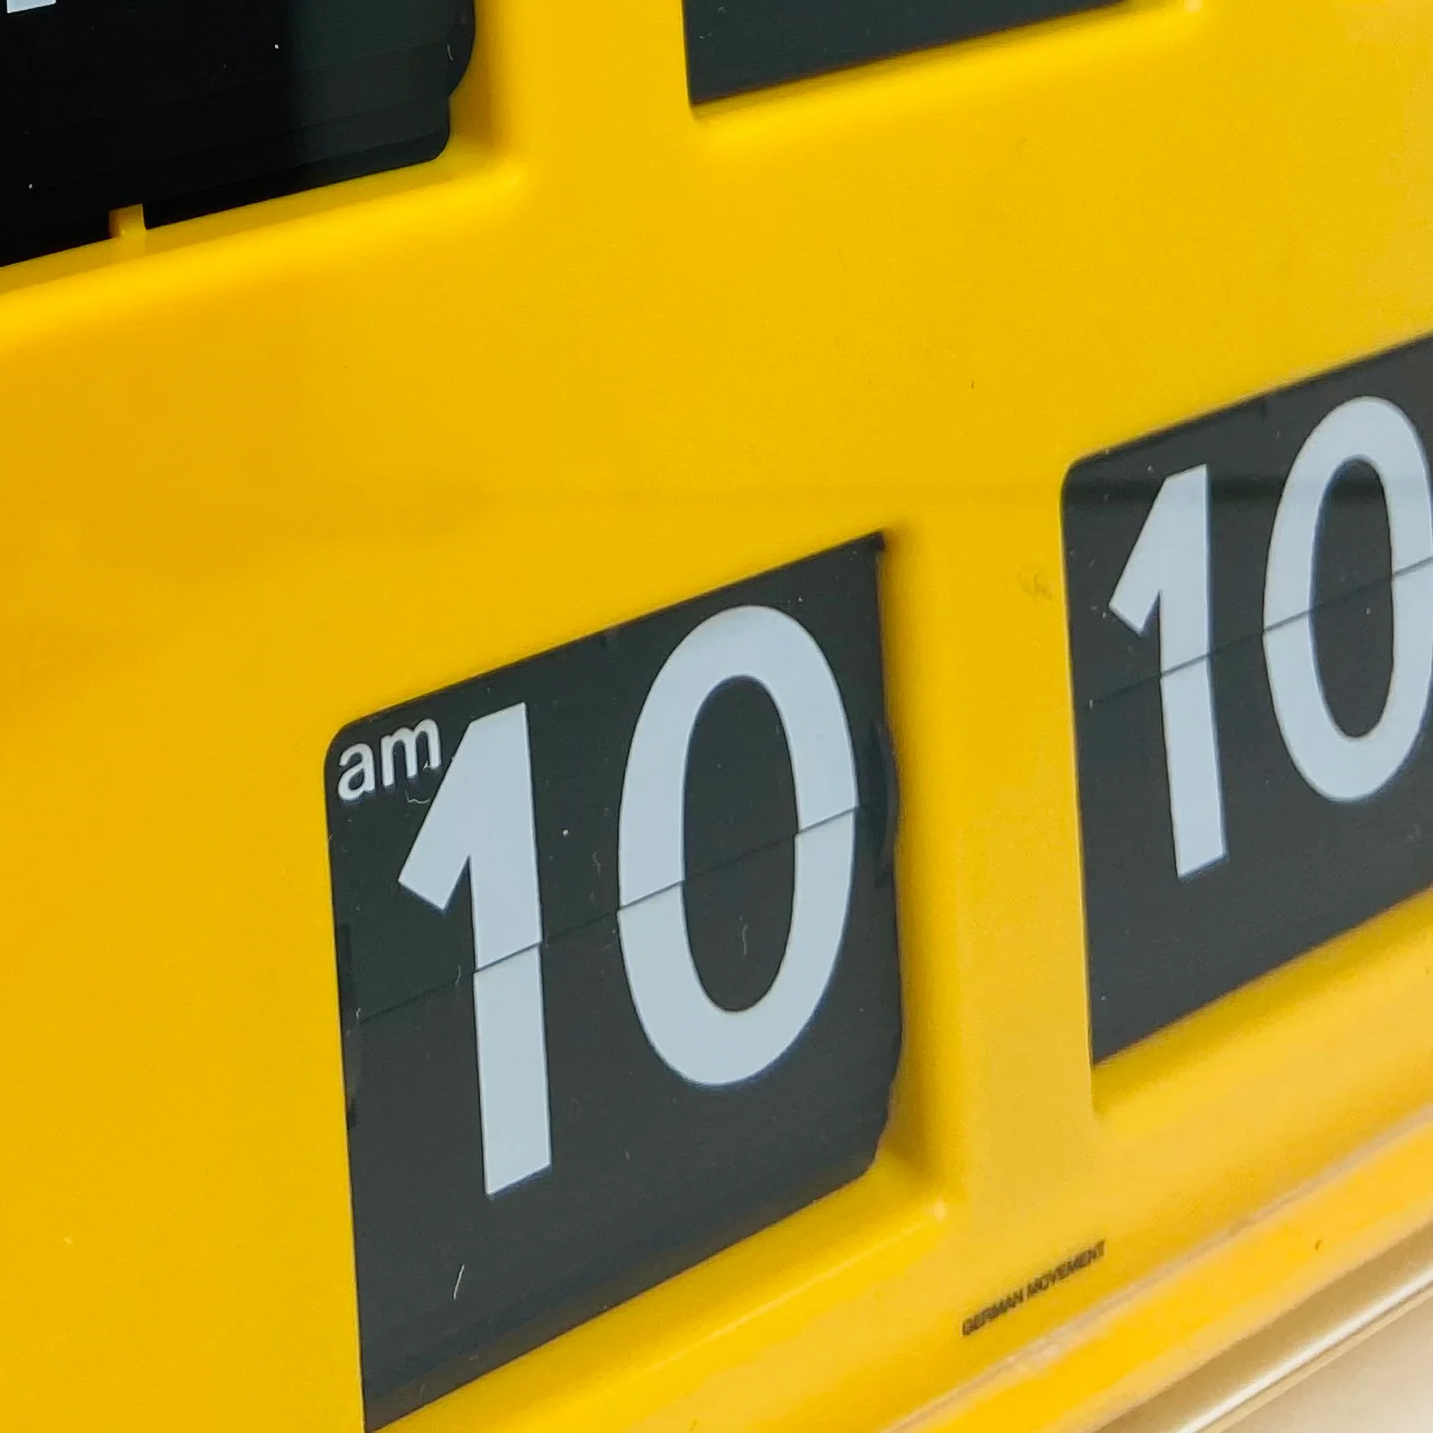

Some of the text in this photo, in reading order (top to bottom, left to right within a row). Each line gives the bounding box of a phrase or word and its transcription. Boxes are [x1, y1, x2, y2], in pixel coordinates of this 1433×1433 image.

[337, 718, 443, 801] am
[1108, 396, 1433, 879] 10
[397, 605, 860, 1197] 10
[962, 1239, 1106, 1336] GERMAN MOVEMENT
